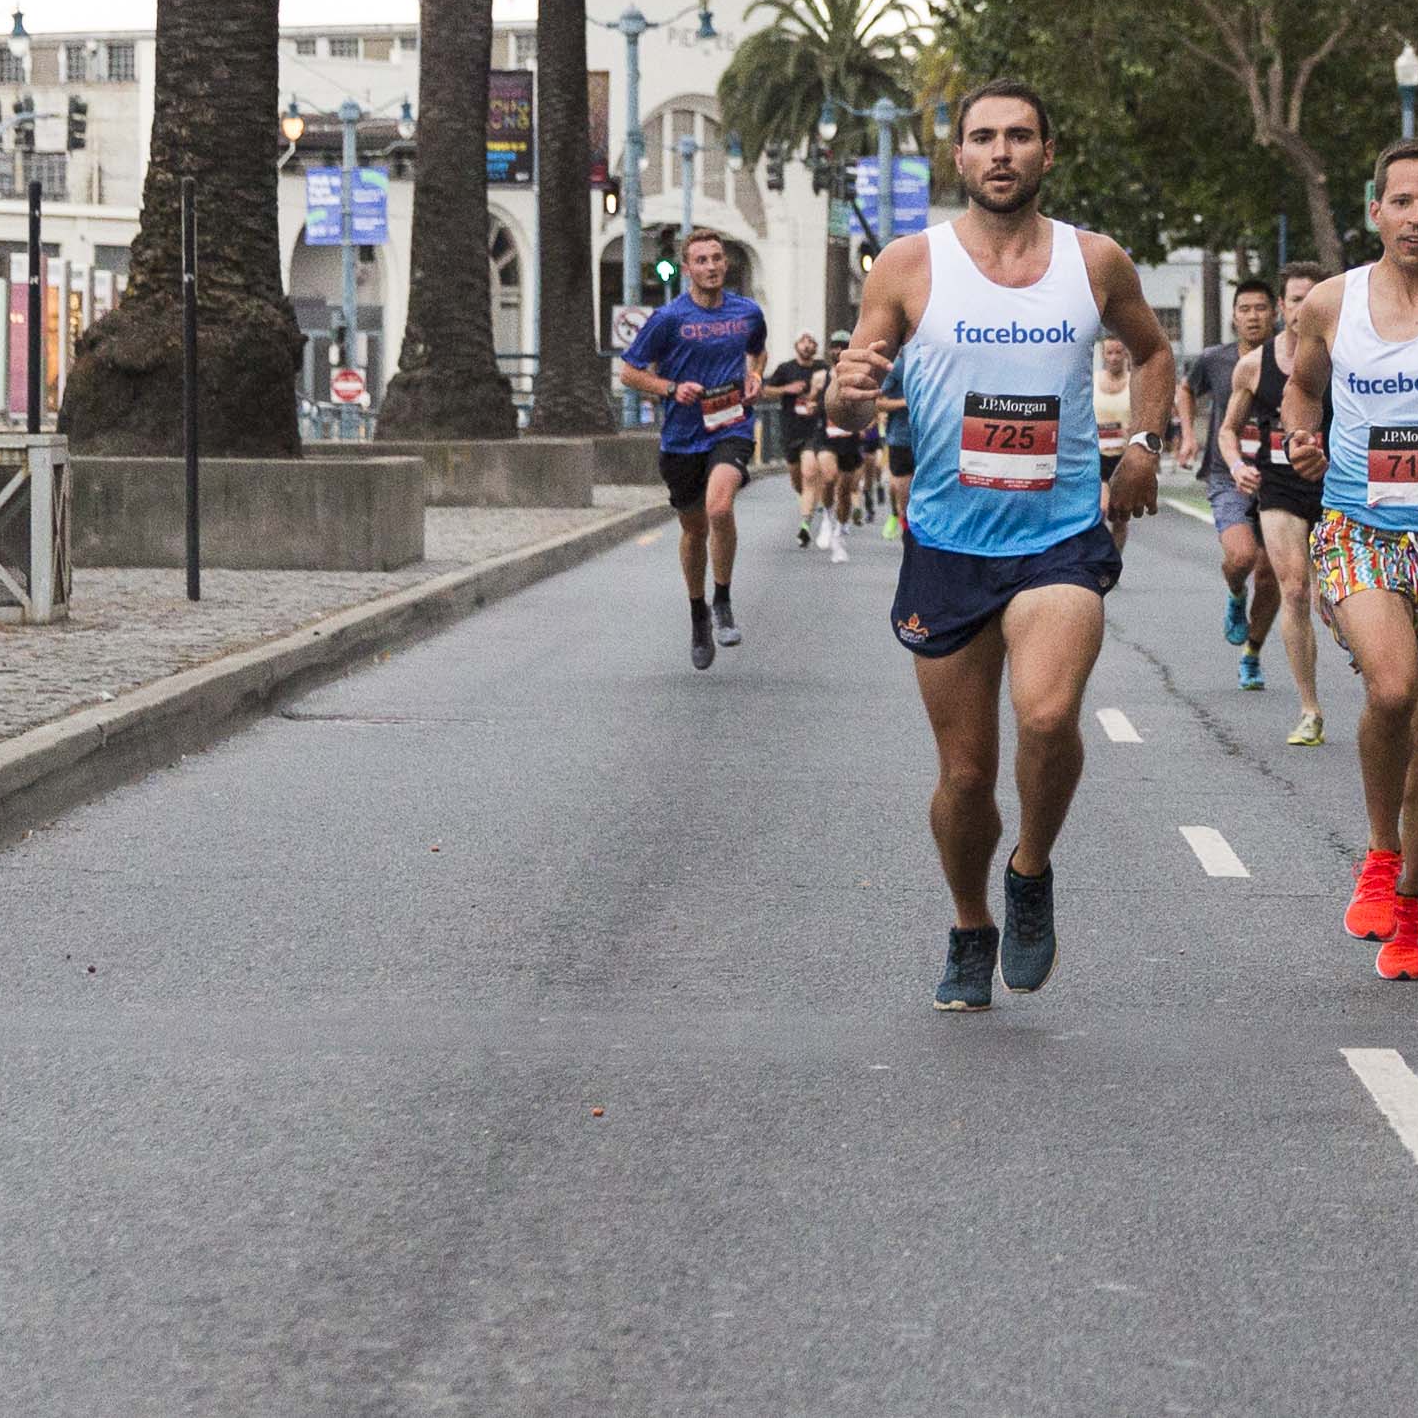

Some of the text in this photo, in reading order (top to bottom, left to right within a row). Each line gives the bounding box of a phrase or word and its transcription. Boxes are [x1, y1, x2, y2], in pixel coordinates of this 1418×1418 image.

[954, 320, 1076, 344] facebook
[978, 398, 1047, 416] J.P.Morgan
[984, 423, 1036, 450] 725
